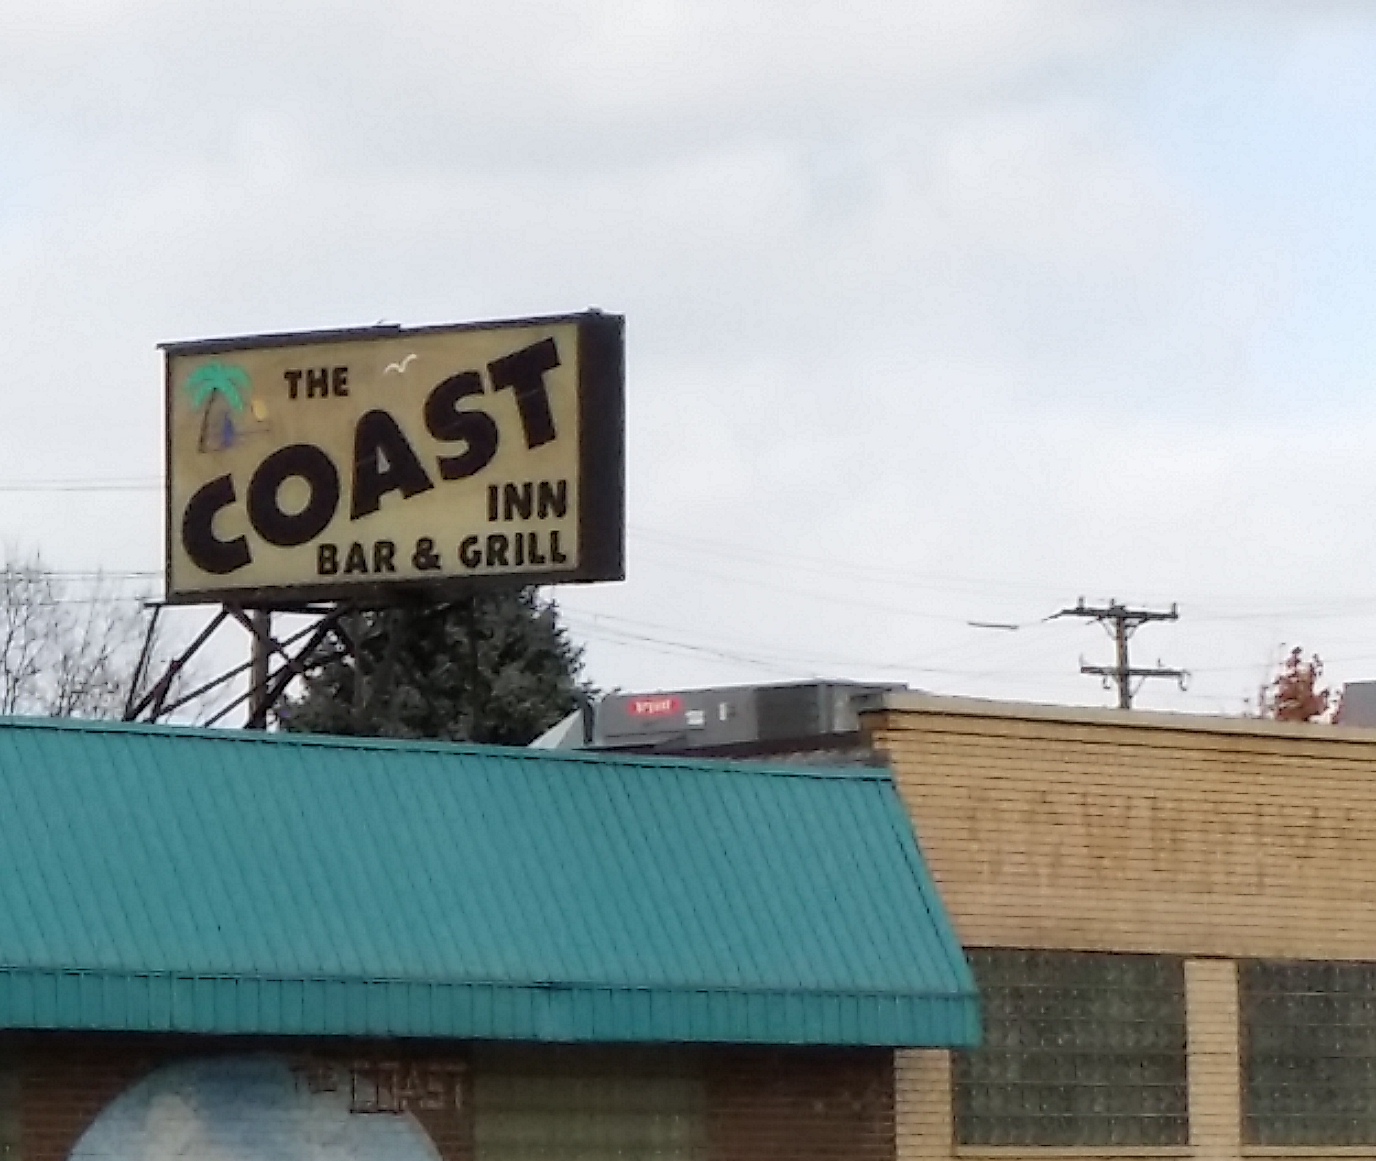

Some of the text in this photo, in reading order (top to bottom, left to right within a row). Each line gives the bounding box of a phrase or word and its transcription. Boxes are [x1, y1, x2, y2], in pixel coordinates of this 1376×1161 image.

[284, 366, 349, 399] THE
[181, 337, 562, 575] COAST
[487, 479, 568, 522] INN
[317, 530, 567, 575] BAR & GRILL
